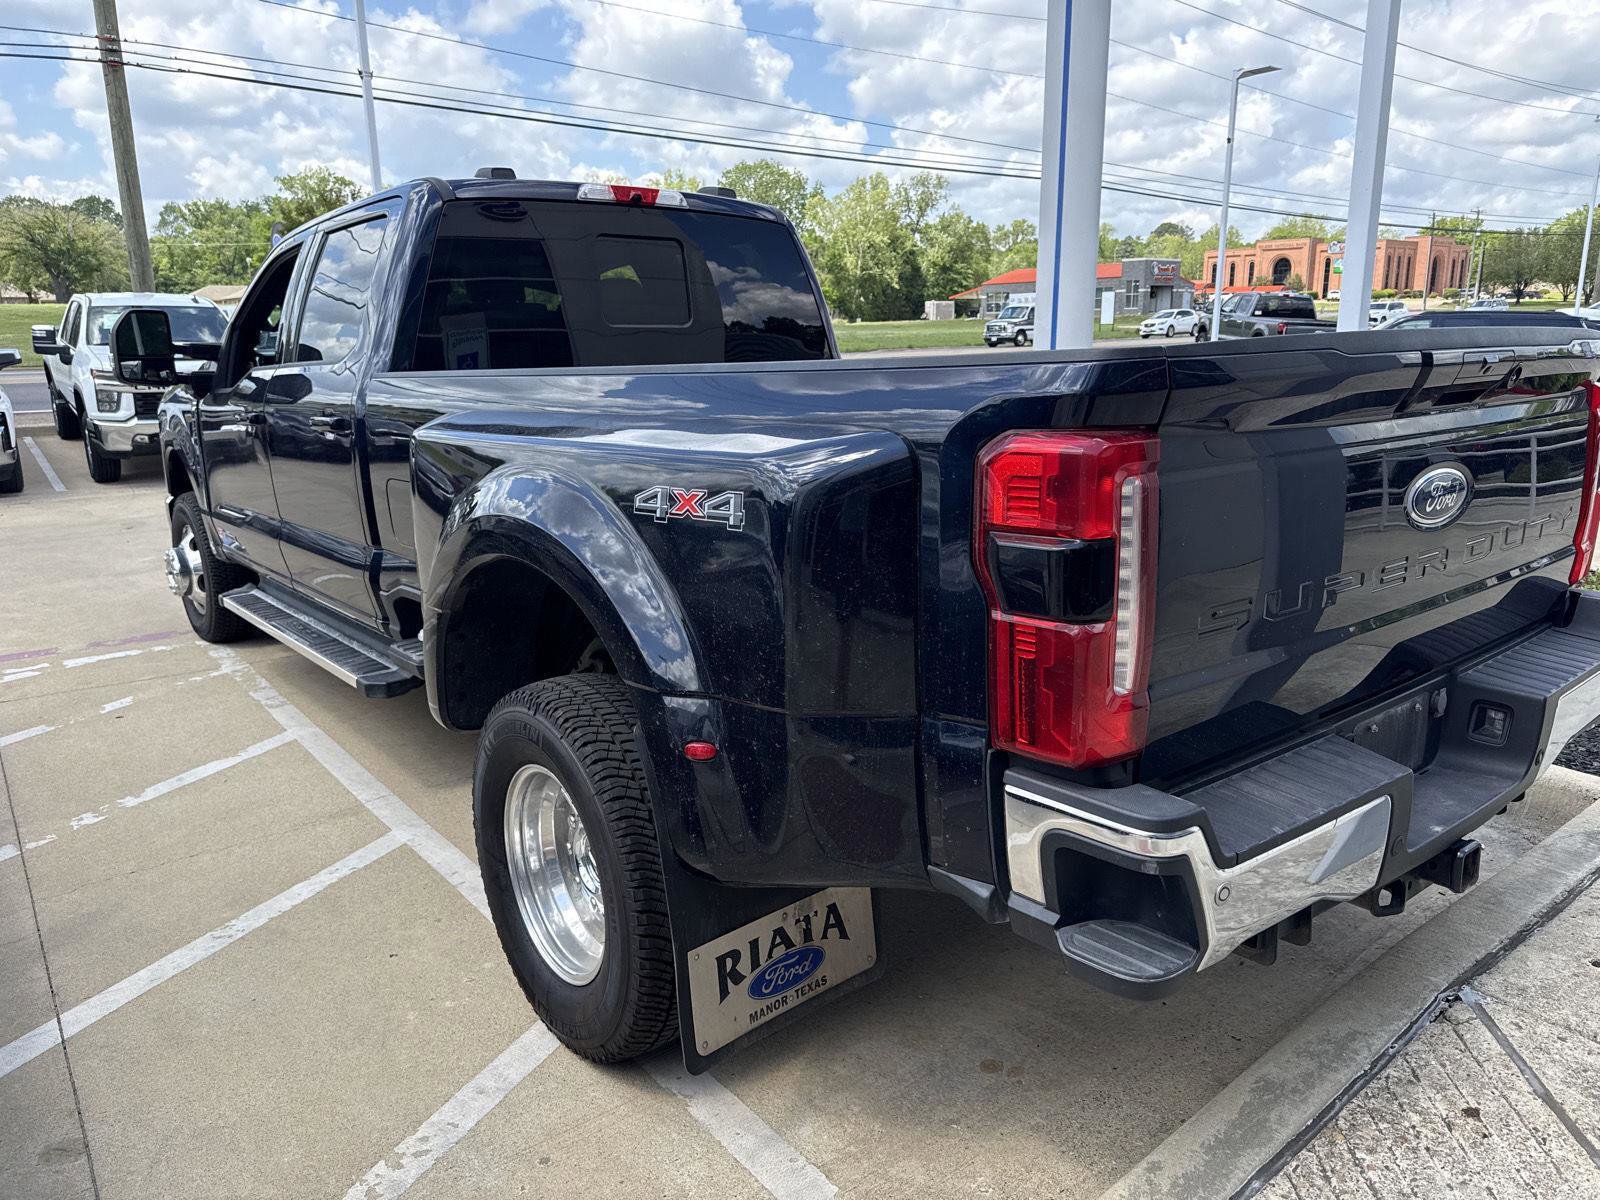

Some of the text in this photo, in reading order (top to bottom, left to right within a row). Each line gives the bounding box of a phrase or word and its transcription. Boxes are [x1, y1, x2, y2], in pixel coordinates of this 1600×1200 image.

[1425, 480, 1461, 512] Ford
[1198, 505, 1573, 638] SUPER DUTY
[715, 902, 850, 1006] RIATA
[761, 953, 814, 994] Ford
[749, 975, 828, 1024] MANOR TEXAS
